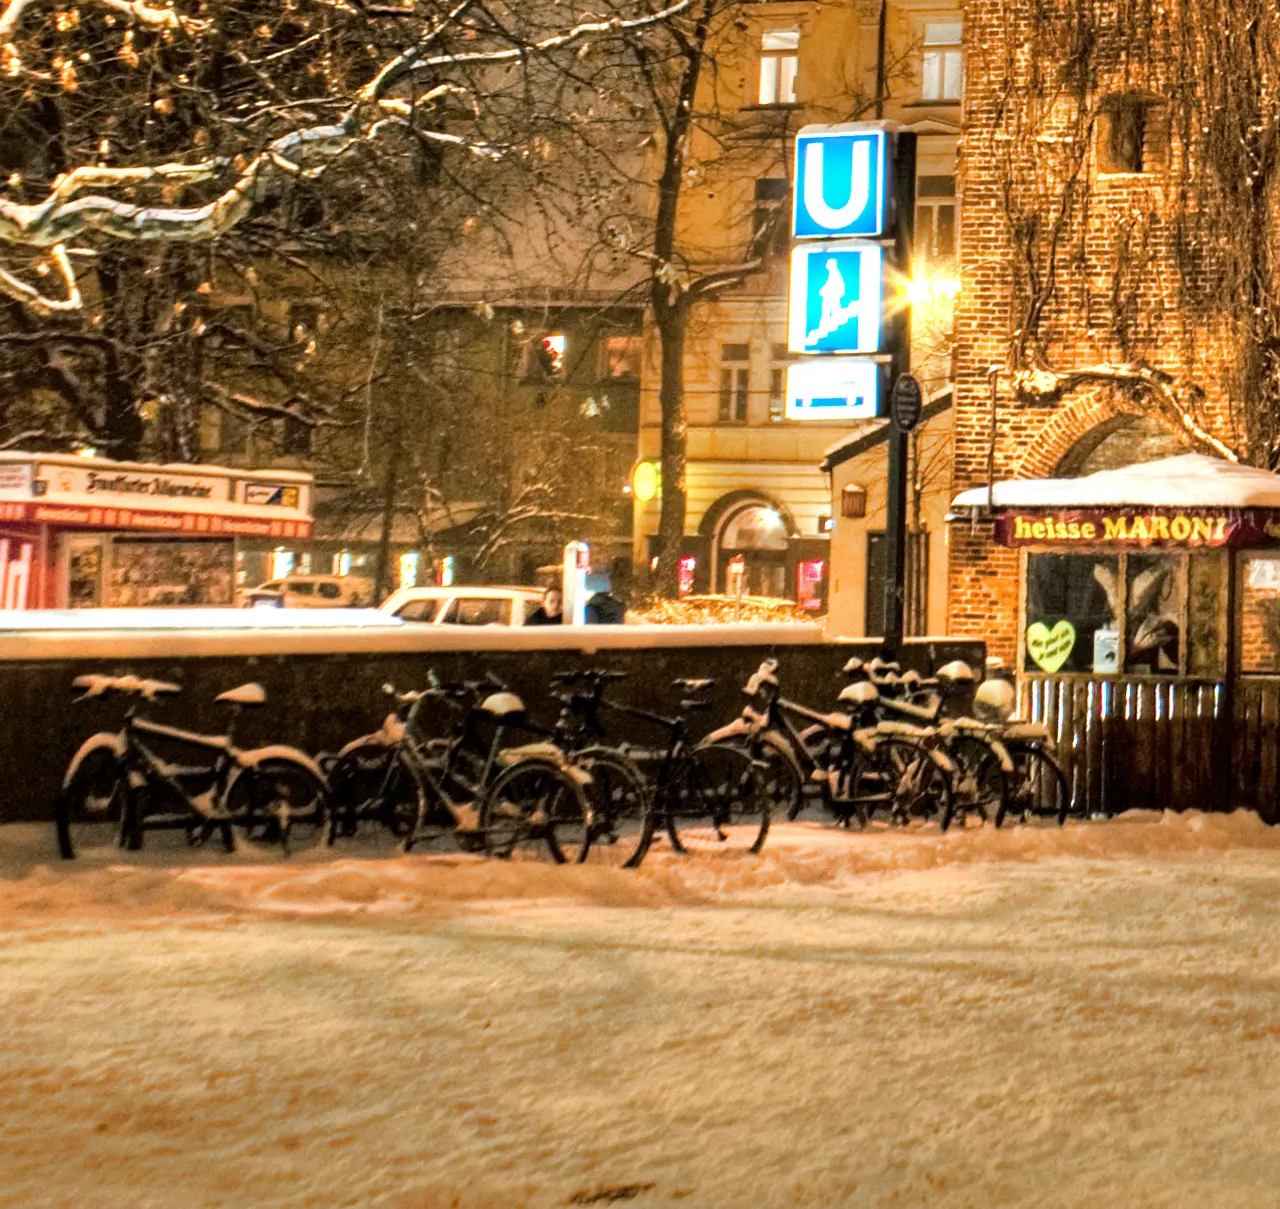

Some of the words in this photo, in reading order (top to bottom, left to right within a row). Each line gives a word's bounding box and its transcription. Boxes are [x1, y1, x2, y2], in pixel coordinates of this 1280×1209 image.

[804, 141, 870, 229] U
[1014, 515, 1096, 539] heisse
[1101, 514, 1228, 540] MARONI
